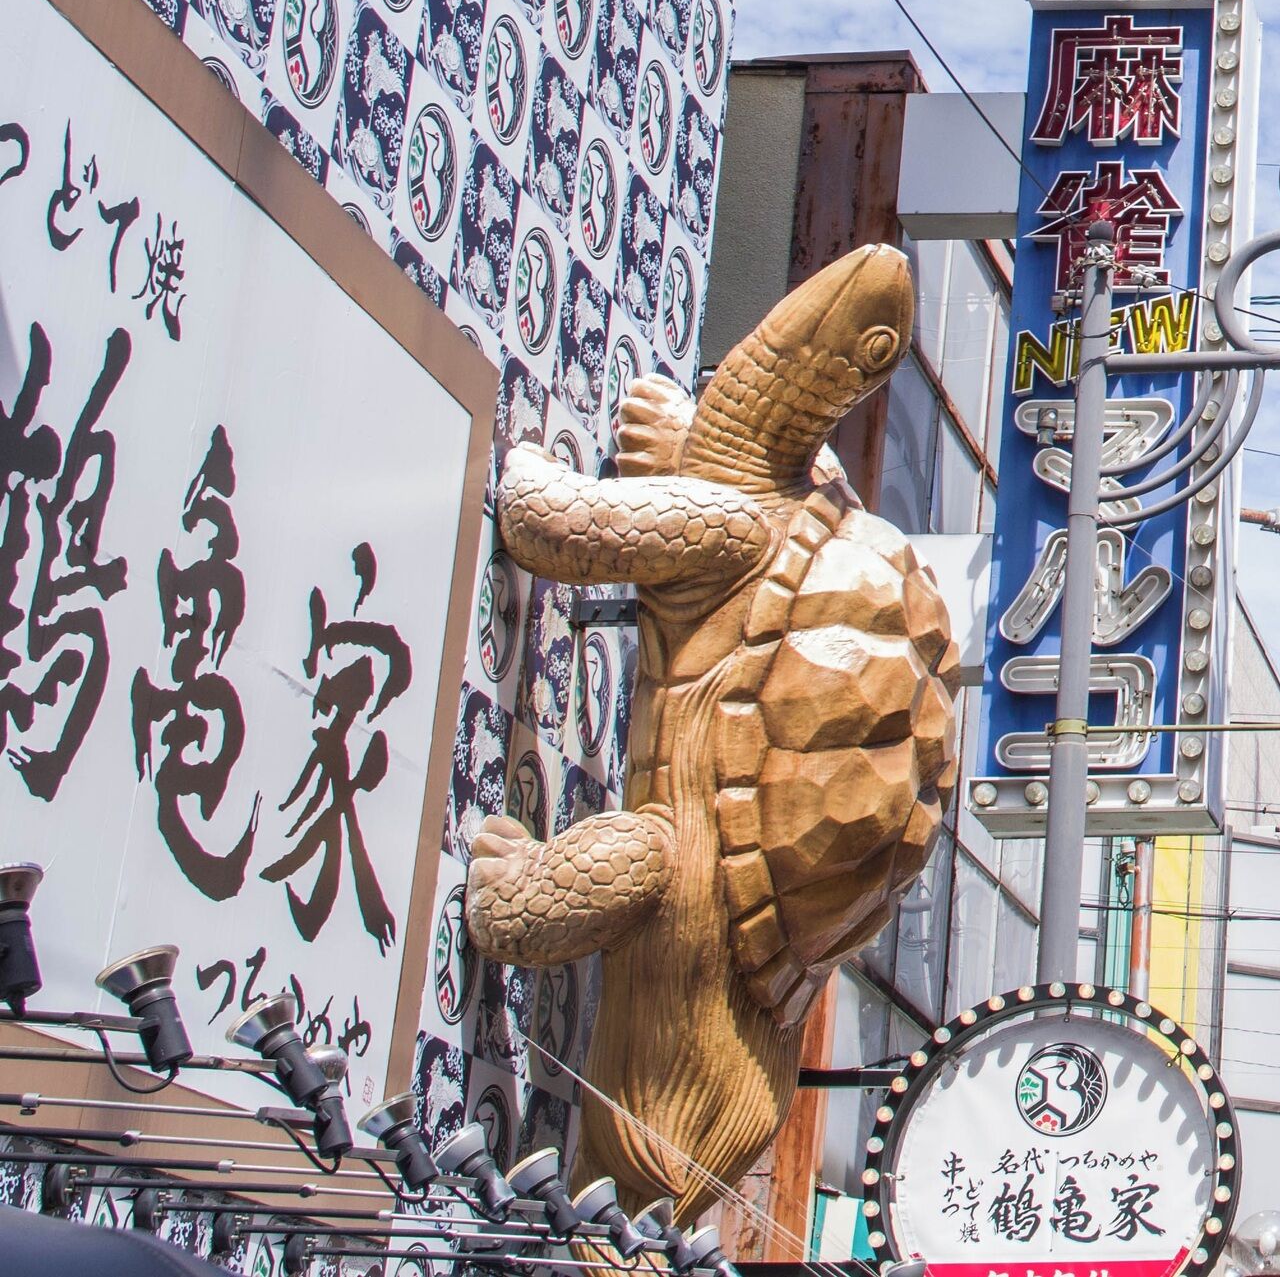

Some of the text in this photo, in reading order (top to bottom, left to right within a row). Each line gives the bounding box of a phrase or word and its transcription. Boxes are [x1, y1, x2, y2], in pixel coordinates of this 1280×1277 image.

[1022, 13, 1187, 294] 麻雀
[988, 1173, 1167, 1243] 鶴亀家
